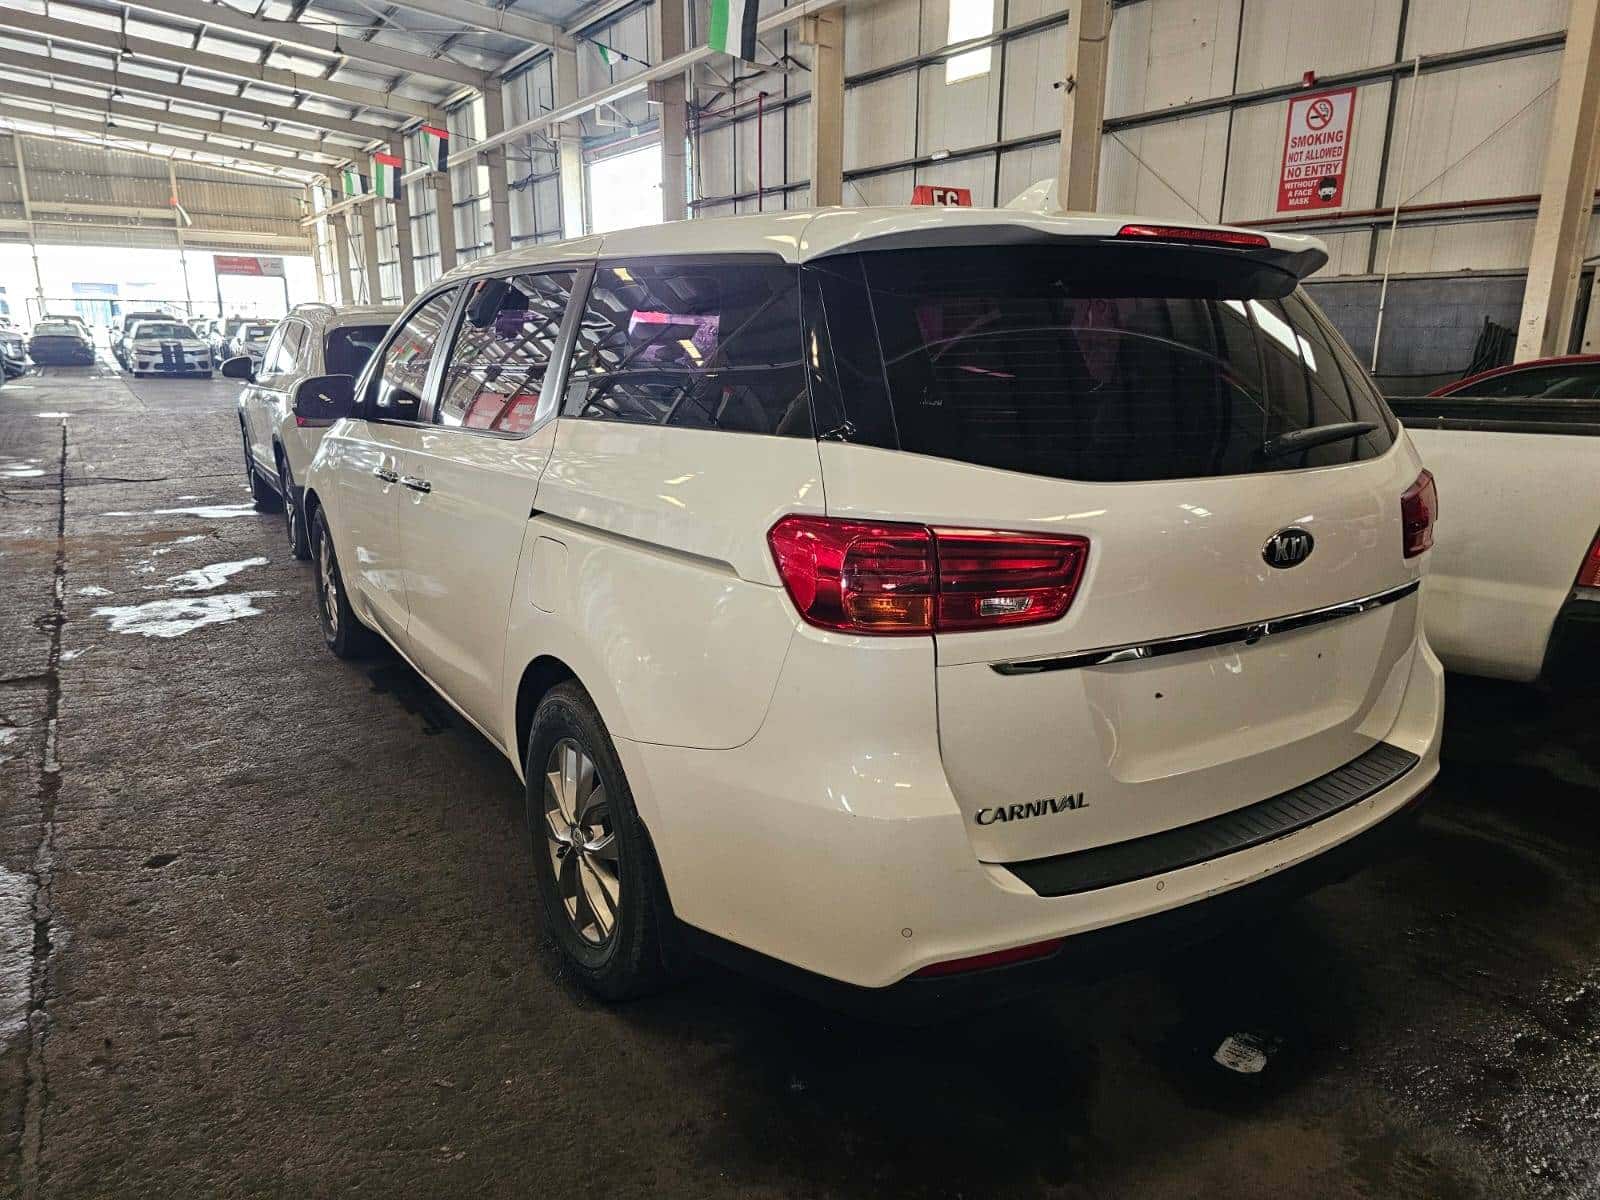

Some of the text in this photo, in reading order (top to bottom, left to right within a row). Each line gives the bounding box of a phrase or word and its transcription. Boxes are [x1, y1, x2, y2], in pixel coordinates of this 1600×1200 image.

[1291, 130, 1343, 148] SMOKING
[1288, 146, 1342, 162] NOT ALLOWED
[1287, 162, 1340, 178] NO ENTRY
[1285, 180, 1318, 189] WITHOUT
[1294, 189, 1313, 197] FACE
[1274, 535, 1310, 562] KIA
[975, 791, 1090, 826] CARNIVAL
